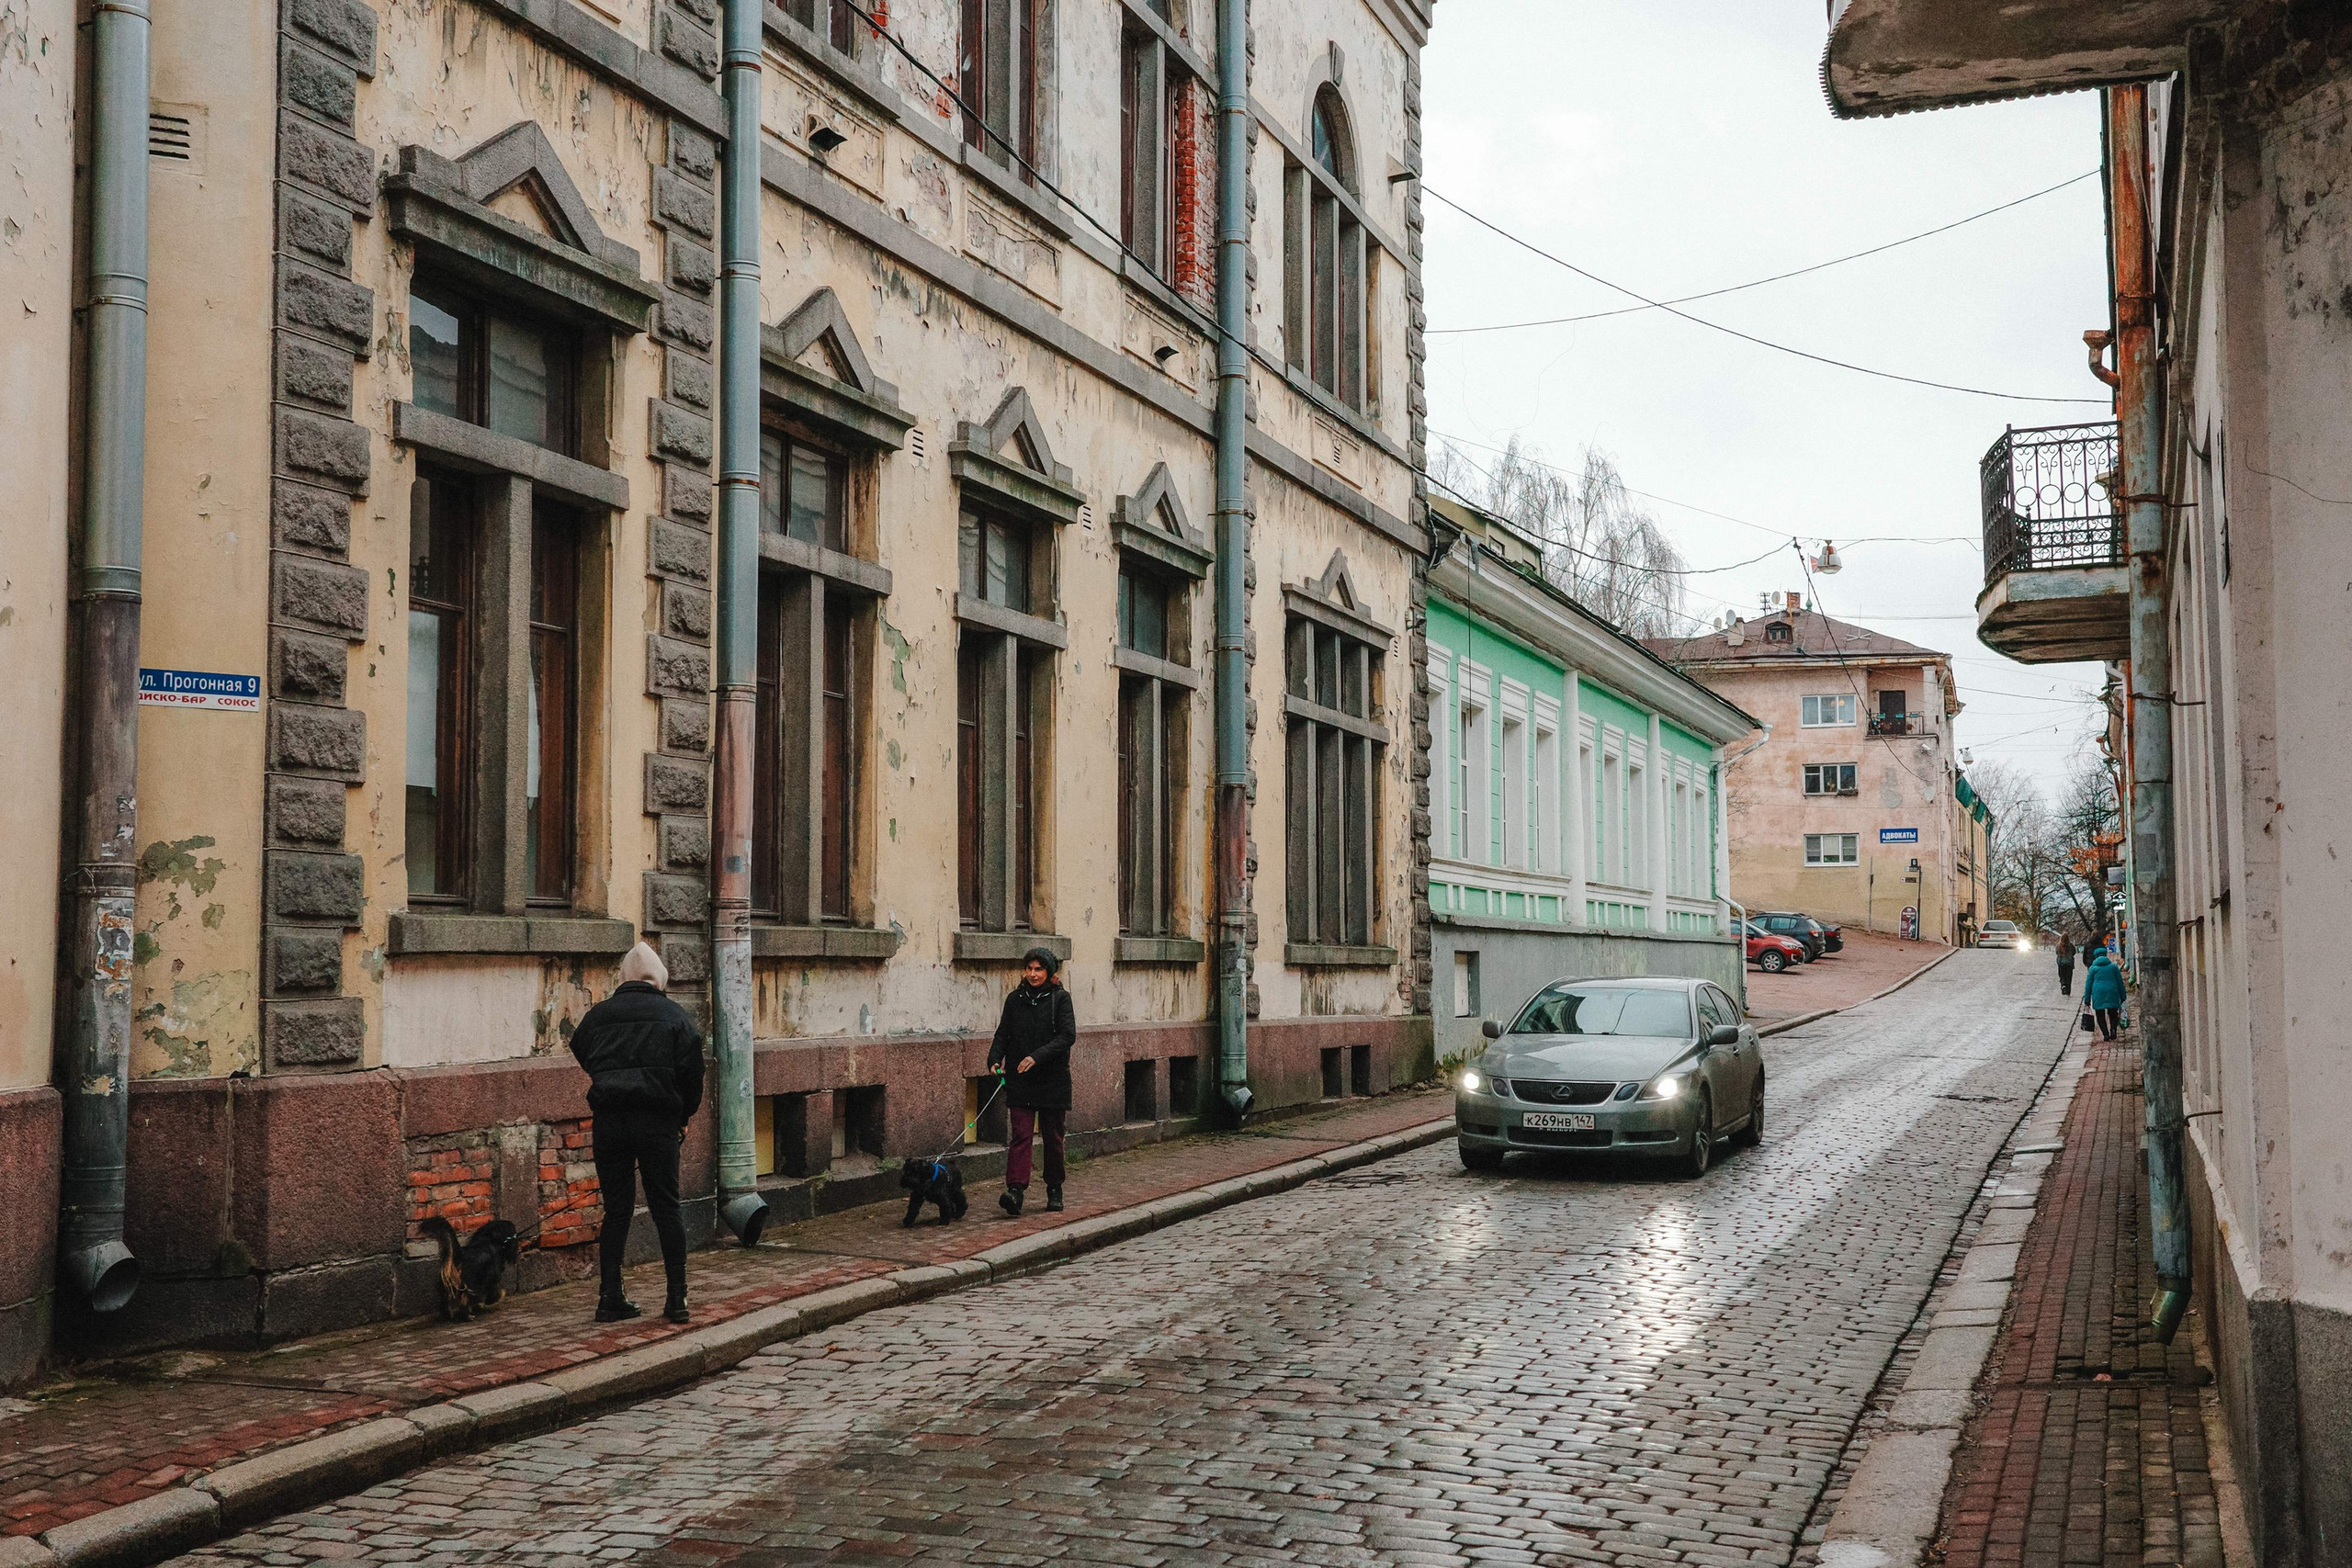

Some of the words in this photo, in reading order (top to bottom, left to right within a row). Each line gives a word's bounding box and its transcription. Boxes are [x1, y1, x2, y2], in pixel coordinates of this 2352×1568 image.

[138, 674, 157, 690] ул.
[164, 672, 243, 693] Прогонная
[247, 678, 256, 694] 9
[217, 697, 256, 707] СОКОС
[1882, 831, 1917, 840] АДВОКАТЫ
[1574, 1115, 1591, 1125] 147
